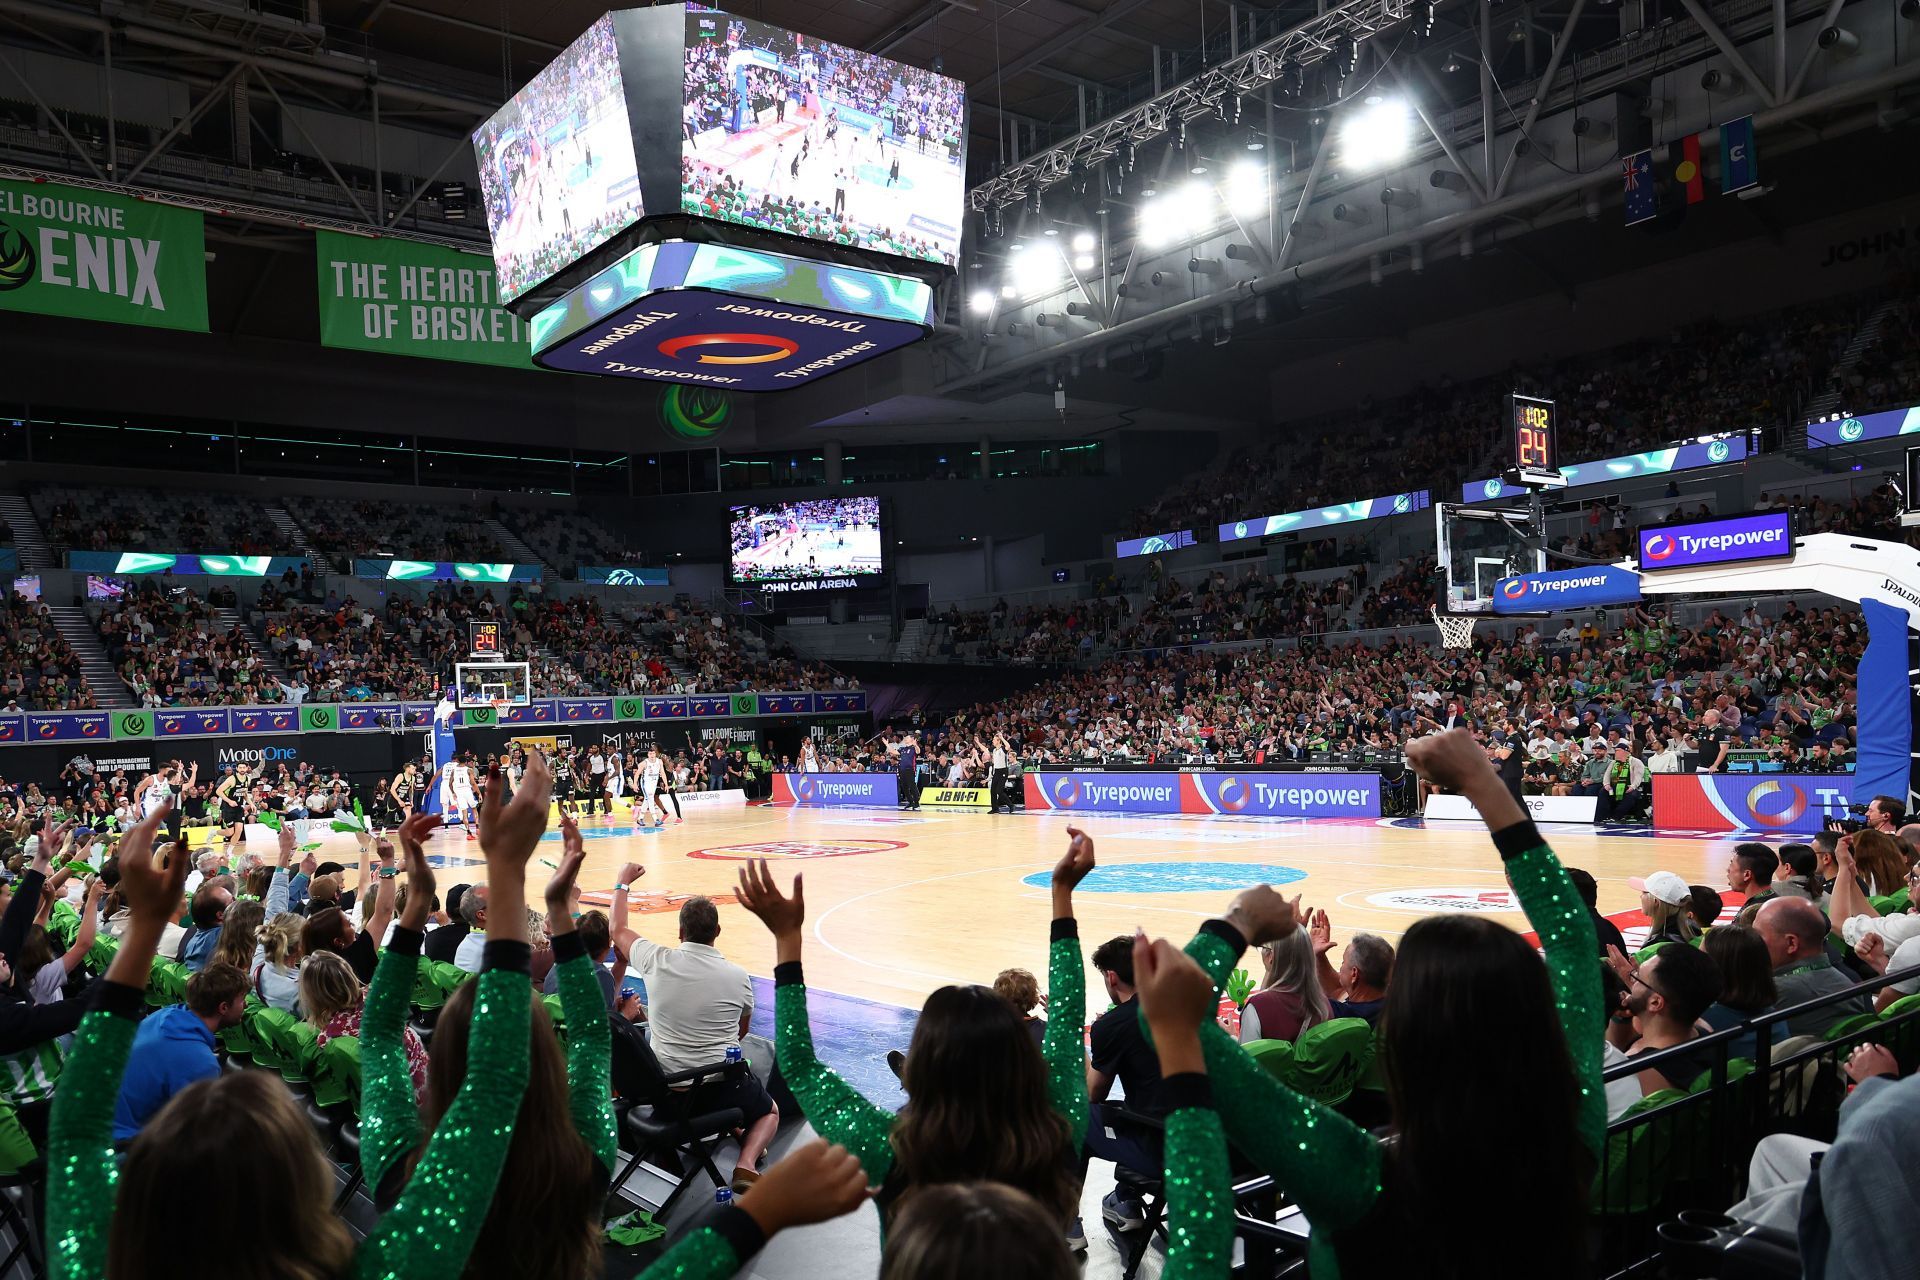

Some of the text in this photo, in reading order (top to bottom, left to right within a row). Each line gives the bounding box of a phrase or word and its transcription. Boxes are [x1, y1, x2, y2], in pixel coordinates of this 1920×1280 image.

[38, 226, 165, 311] ENIX
[330, 261, 502, 305] THE HEART
[363, 303, 531, 343] OF BASKET
[715, 303, 868, 333] Tyrepower
[579, 311, 679, 355] Tyrepower
[773, 340, 878, 381] Tyrepower
[603, 360, 742, 386] Tyrepower
[1525, 407, 1548, 429] 1:02
[1519, 428, 1548, 465] 24
[1679, 527, 1785, 555] Tyrepower
[760, 579, 857, 592] JOHN CAIN ARENA
[1530, 574, 1608, 594] Tyrepower
[480, 625, 497, 634] 1:02
[476, 634, 495, 650] 24
[557, 740, 570, 749] CAT
[625, 731, 656, 740] MAPLE
[701, 728, 756, 742] WELCOME FIREPIT
[1727, 754, 1769, 762] MELBOURNE
[680, 793, 699, 802] intel
[817, 780, 873, 799] Tyrepower
[936, 791, 978, 802] JB HI-FI
[1083, 782, 1172, 806] Tyrepower
[1255, 783, 1370, 810] Tyrepower
